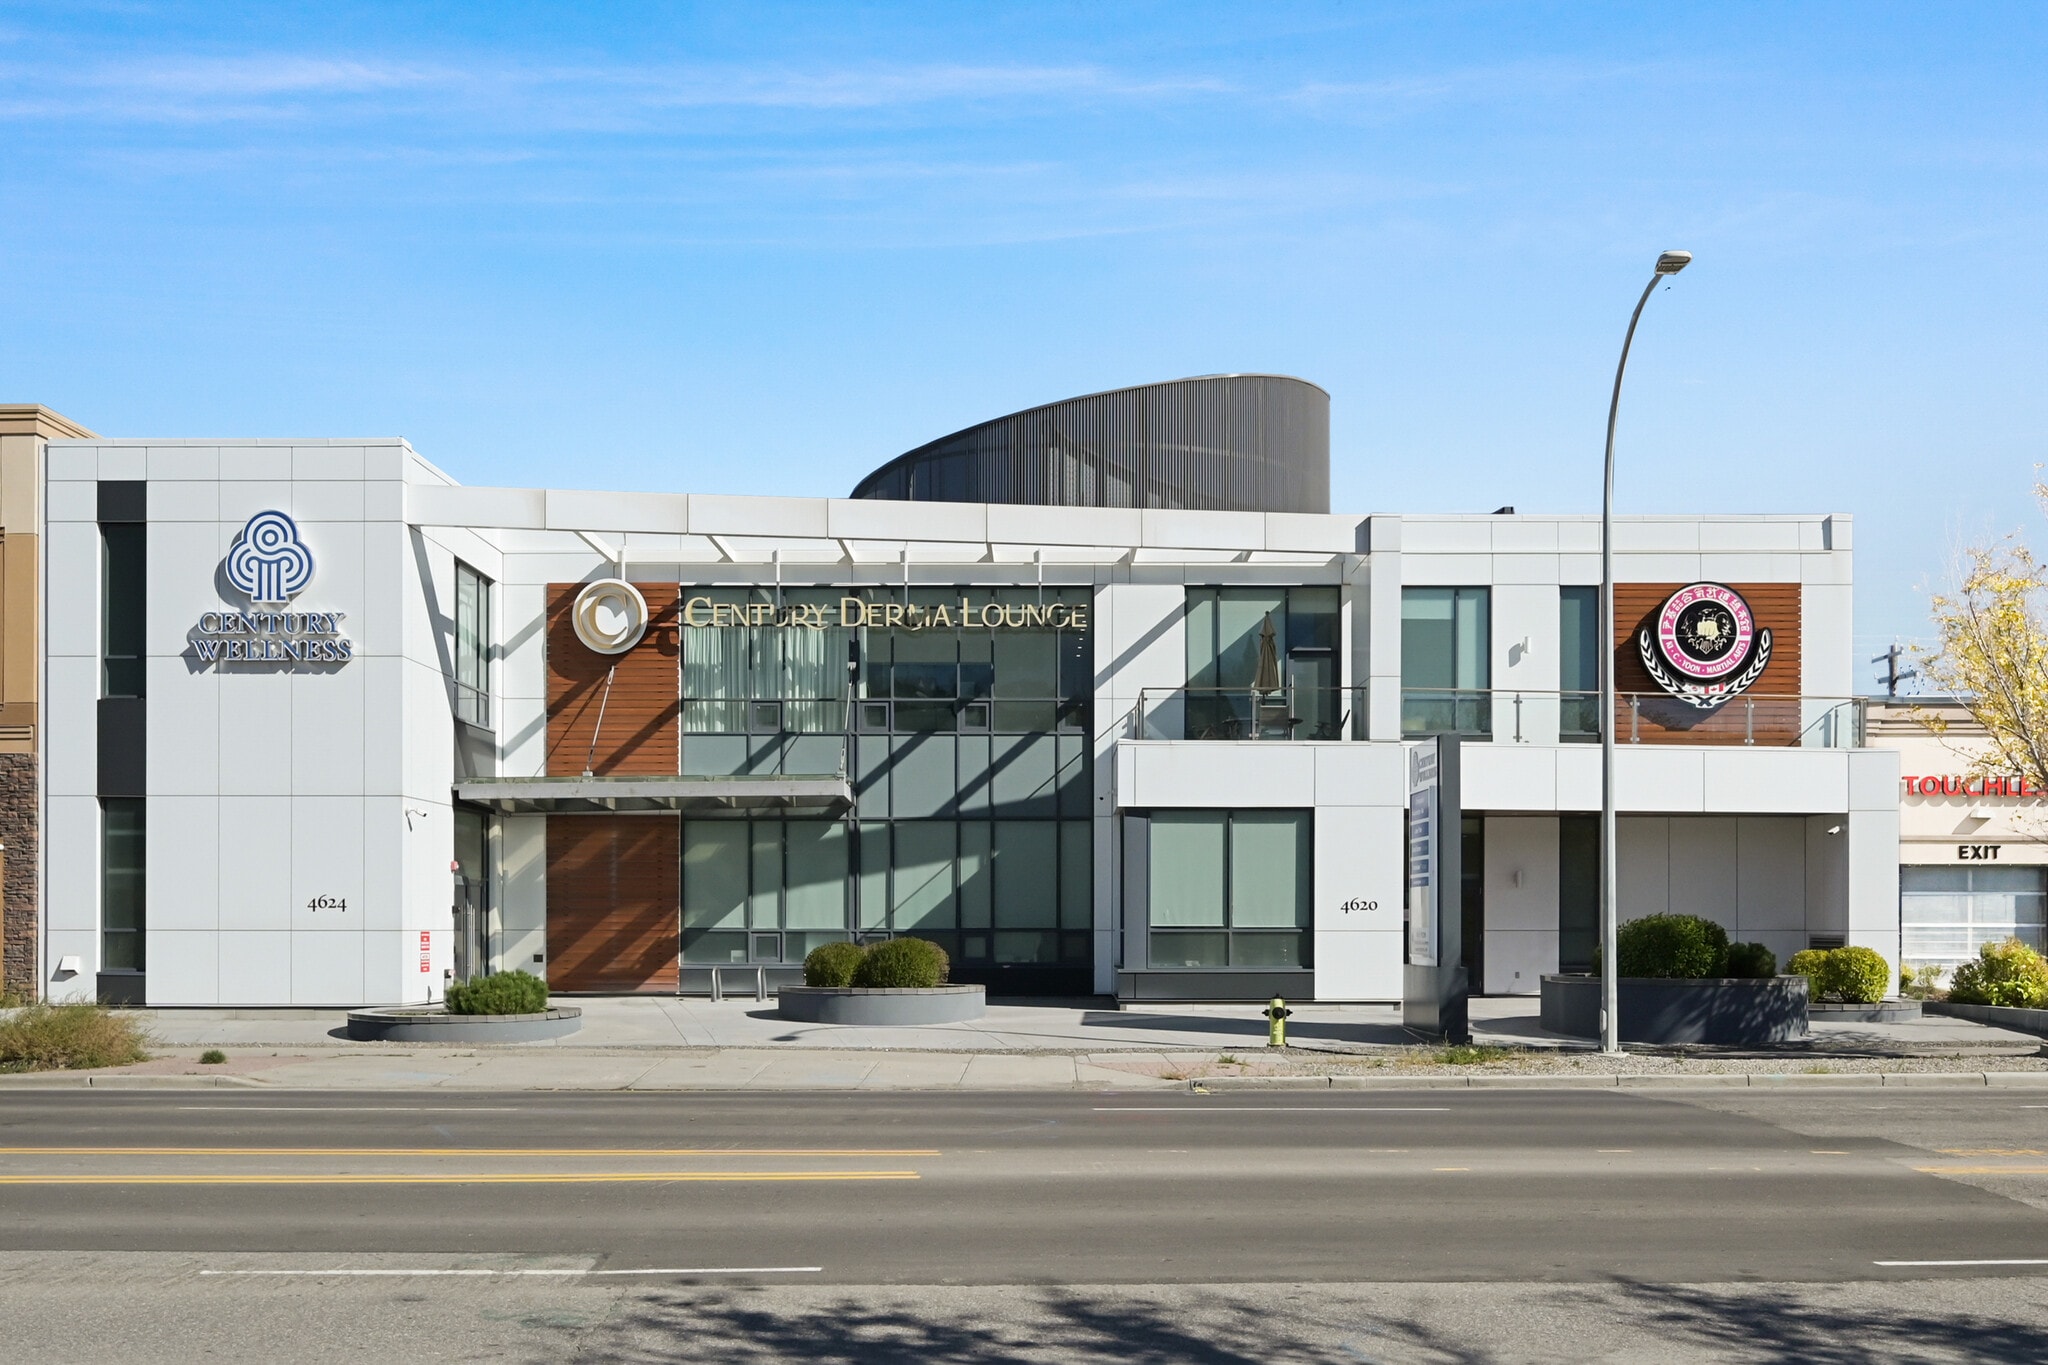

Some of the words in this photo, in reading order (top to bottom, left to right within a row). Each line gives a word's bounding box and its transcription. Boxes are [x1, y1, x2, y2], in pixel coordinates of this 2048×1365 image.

[198, 612, 345, 635] CENTURY
[684, 597, 828, 631] CENTURY
[840, 597, 951, 631] DERMA
[963, 597, 1088, 628] LOUNGE
[192, 639, 354, 662] WELLNESS
[1681, 660, 1701, 673] YOON
[1706, 657, 1736, 674] MARTIAL
[1733, 641, 1747, 658] ARTS
[1902, 775, 2048, 797] TOUCHLE
[1958, 845, 2002, 860] EXIT
[307, 894, 348, 912] 4624
[1340, 896, 1379, 914] 4620
